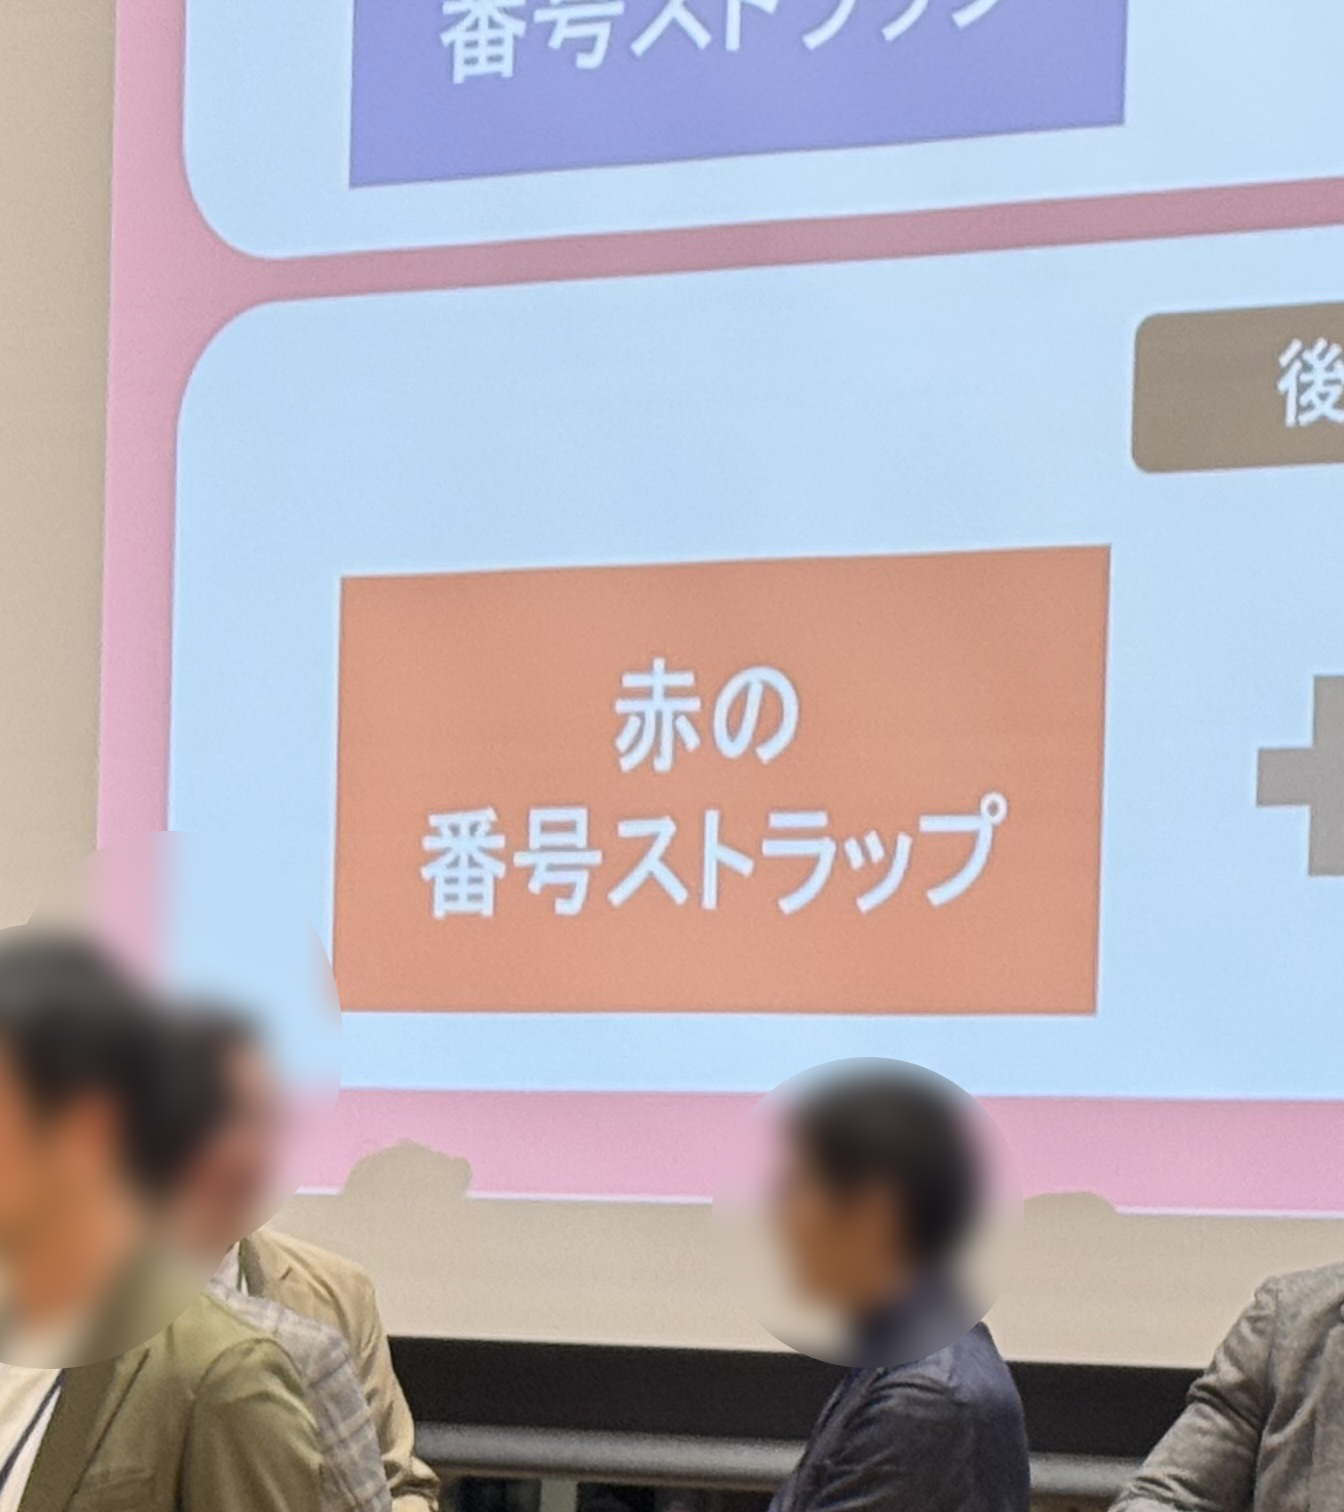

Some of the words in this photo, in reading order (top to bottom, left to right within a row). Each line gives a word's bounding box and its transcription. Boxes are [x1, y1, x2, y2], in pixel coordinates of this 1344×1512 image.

[615, 658, 799, 772] 赤の
[421, 792, 1008, 918] 番号ストラップ
